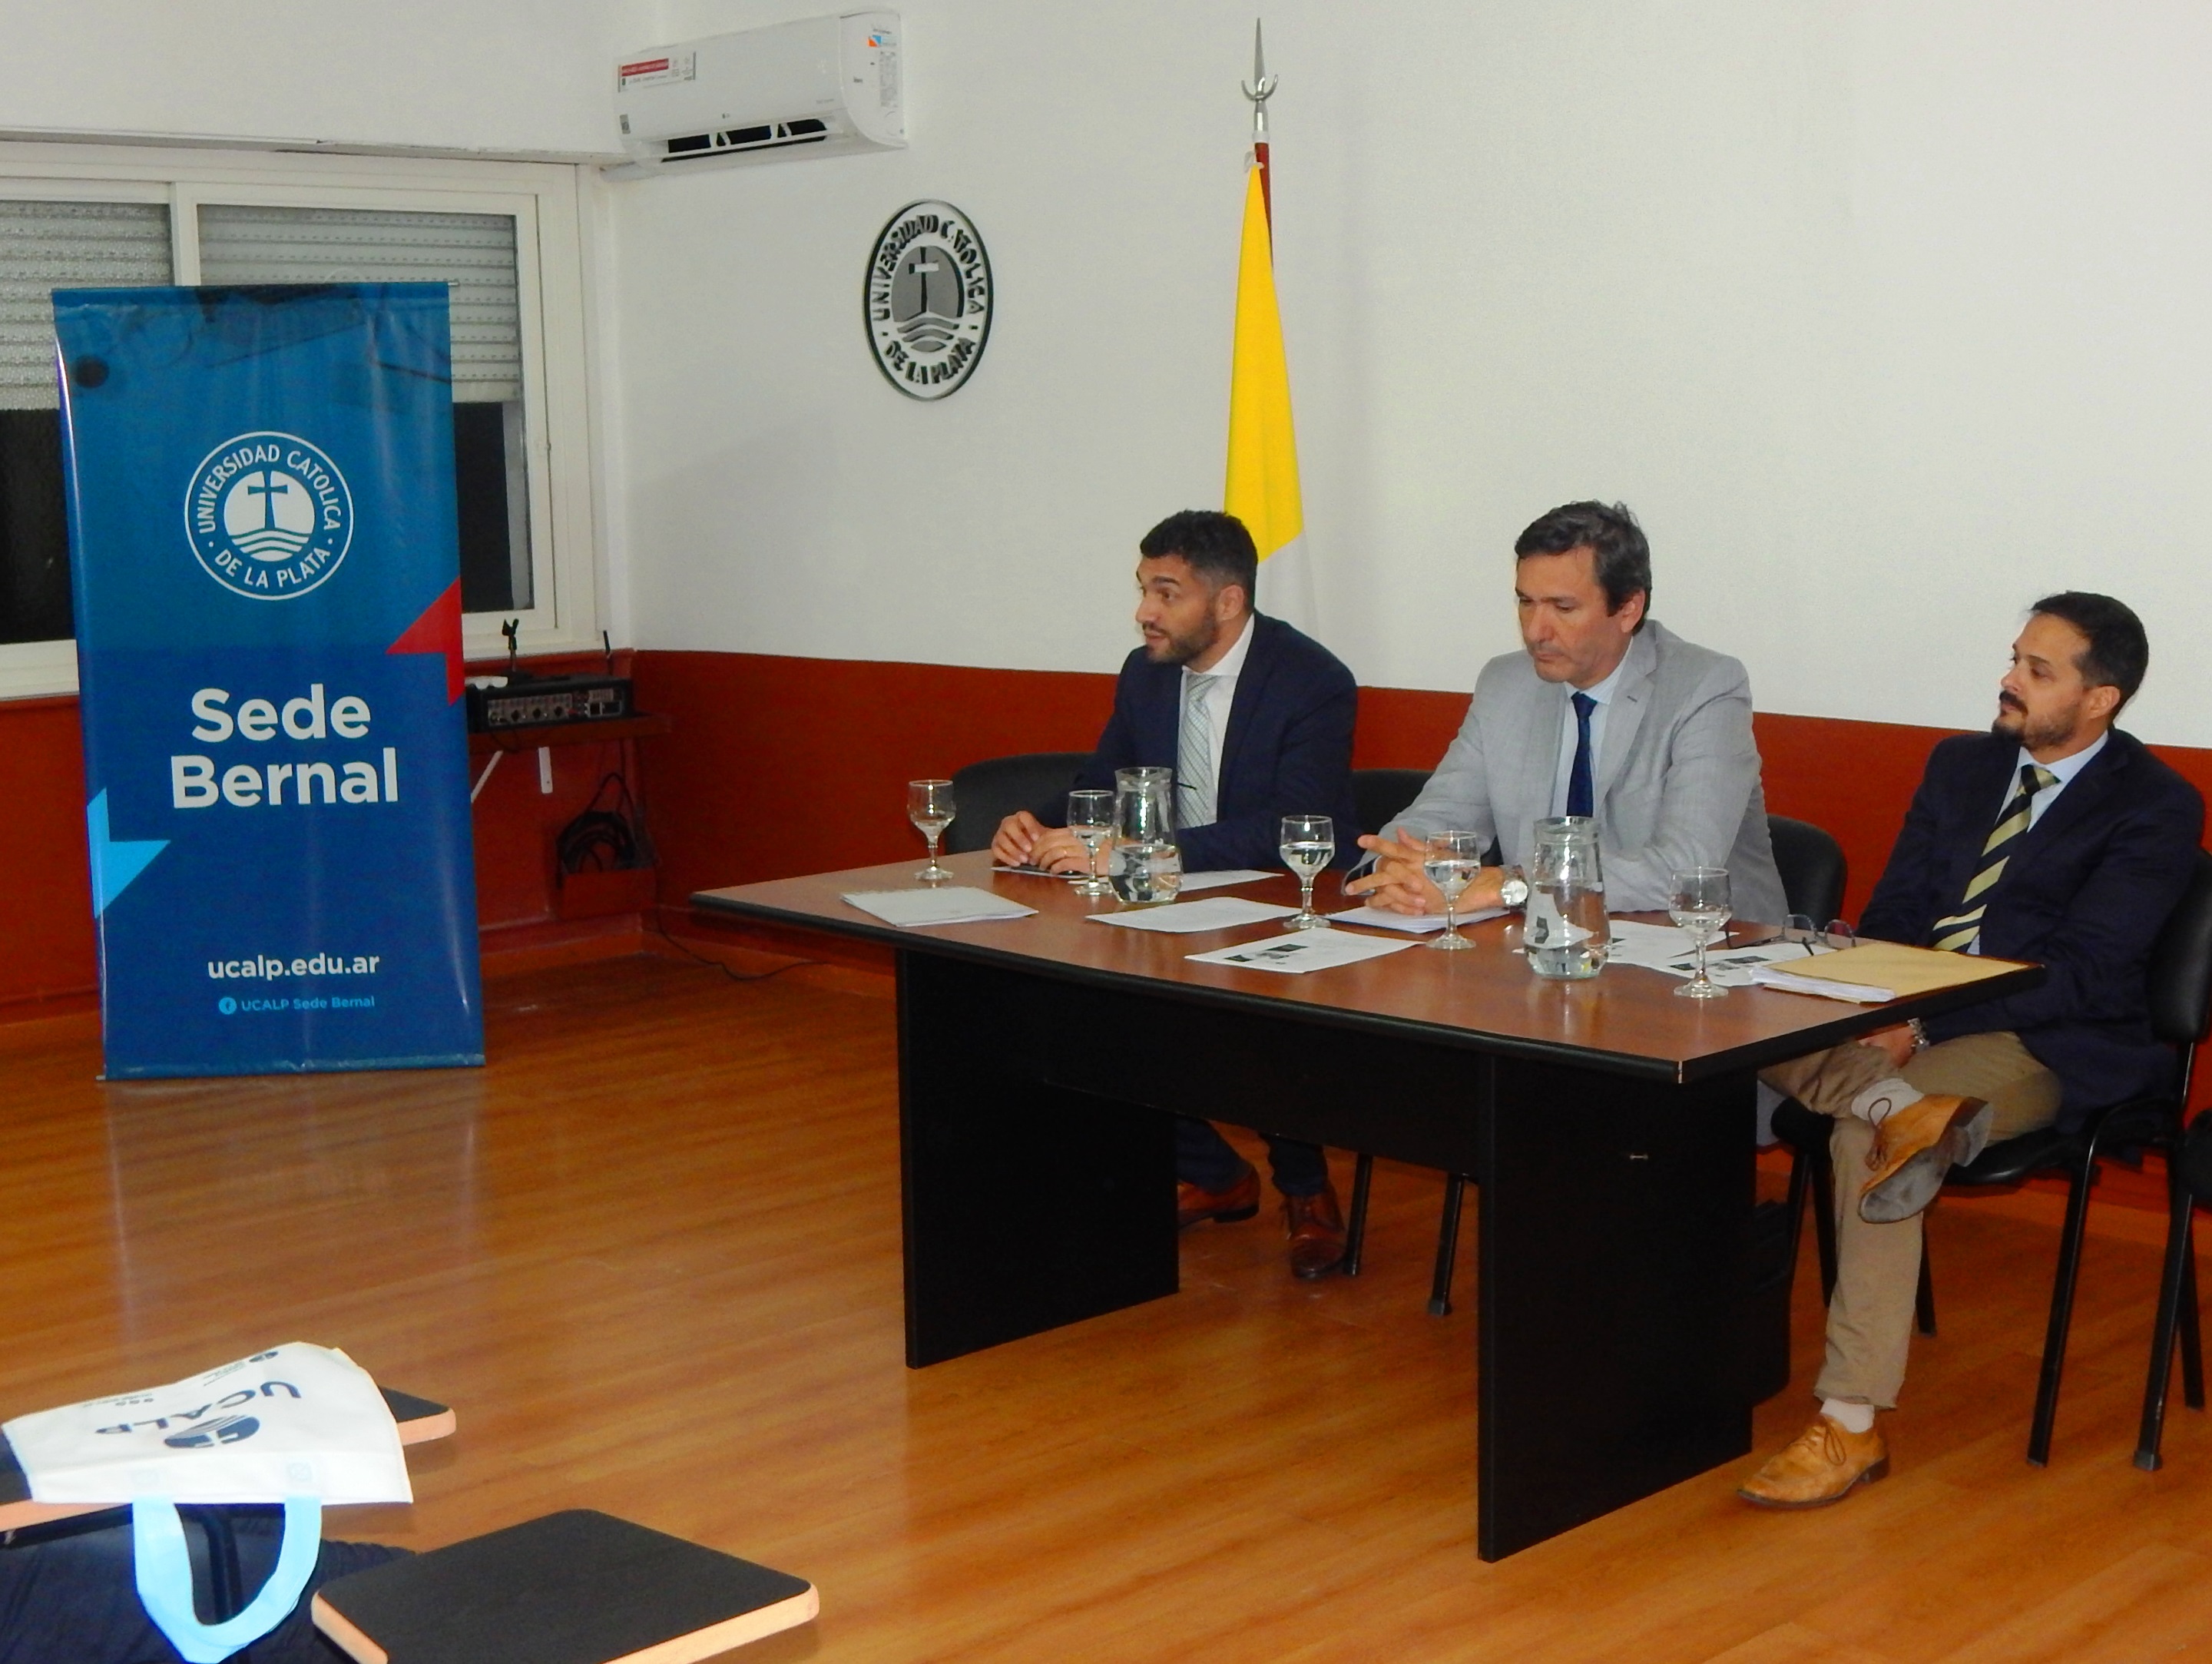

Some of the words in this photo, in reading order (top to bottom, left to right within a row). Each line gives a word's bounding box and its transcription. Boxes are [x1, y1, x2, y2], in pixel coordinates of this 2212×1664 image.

[871, 214, 939, 320] UNIVERSIDAD
[883, 339, 909, 371] DE
[905, 361, 929, 385] LA
[931, 336, 976, 384] PLATA
[197, 444, 280, 534] UNIVERSIDAD
[286, 450, 343, 531] CATOLICA
[214, 548, 243, 577] DE
[243, 566, 269, 589] LA
[276, 547, 331, 588] PLATA
[191, 683, 371, 743] Sede
[171, 747, 399, 809] Bernal
[207, 952, 381, 981] ucalp.edu.ar
[241, 999, 290, 1011] UCALP
[293, 998, 327, 1009] Sede
[331, 996, 375, 1009] Bernal
[94, 1381, 302, 1435] UCALP
